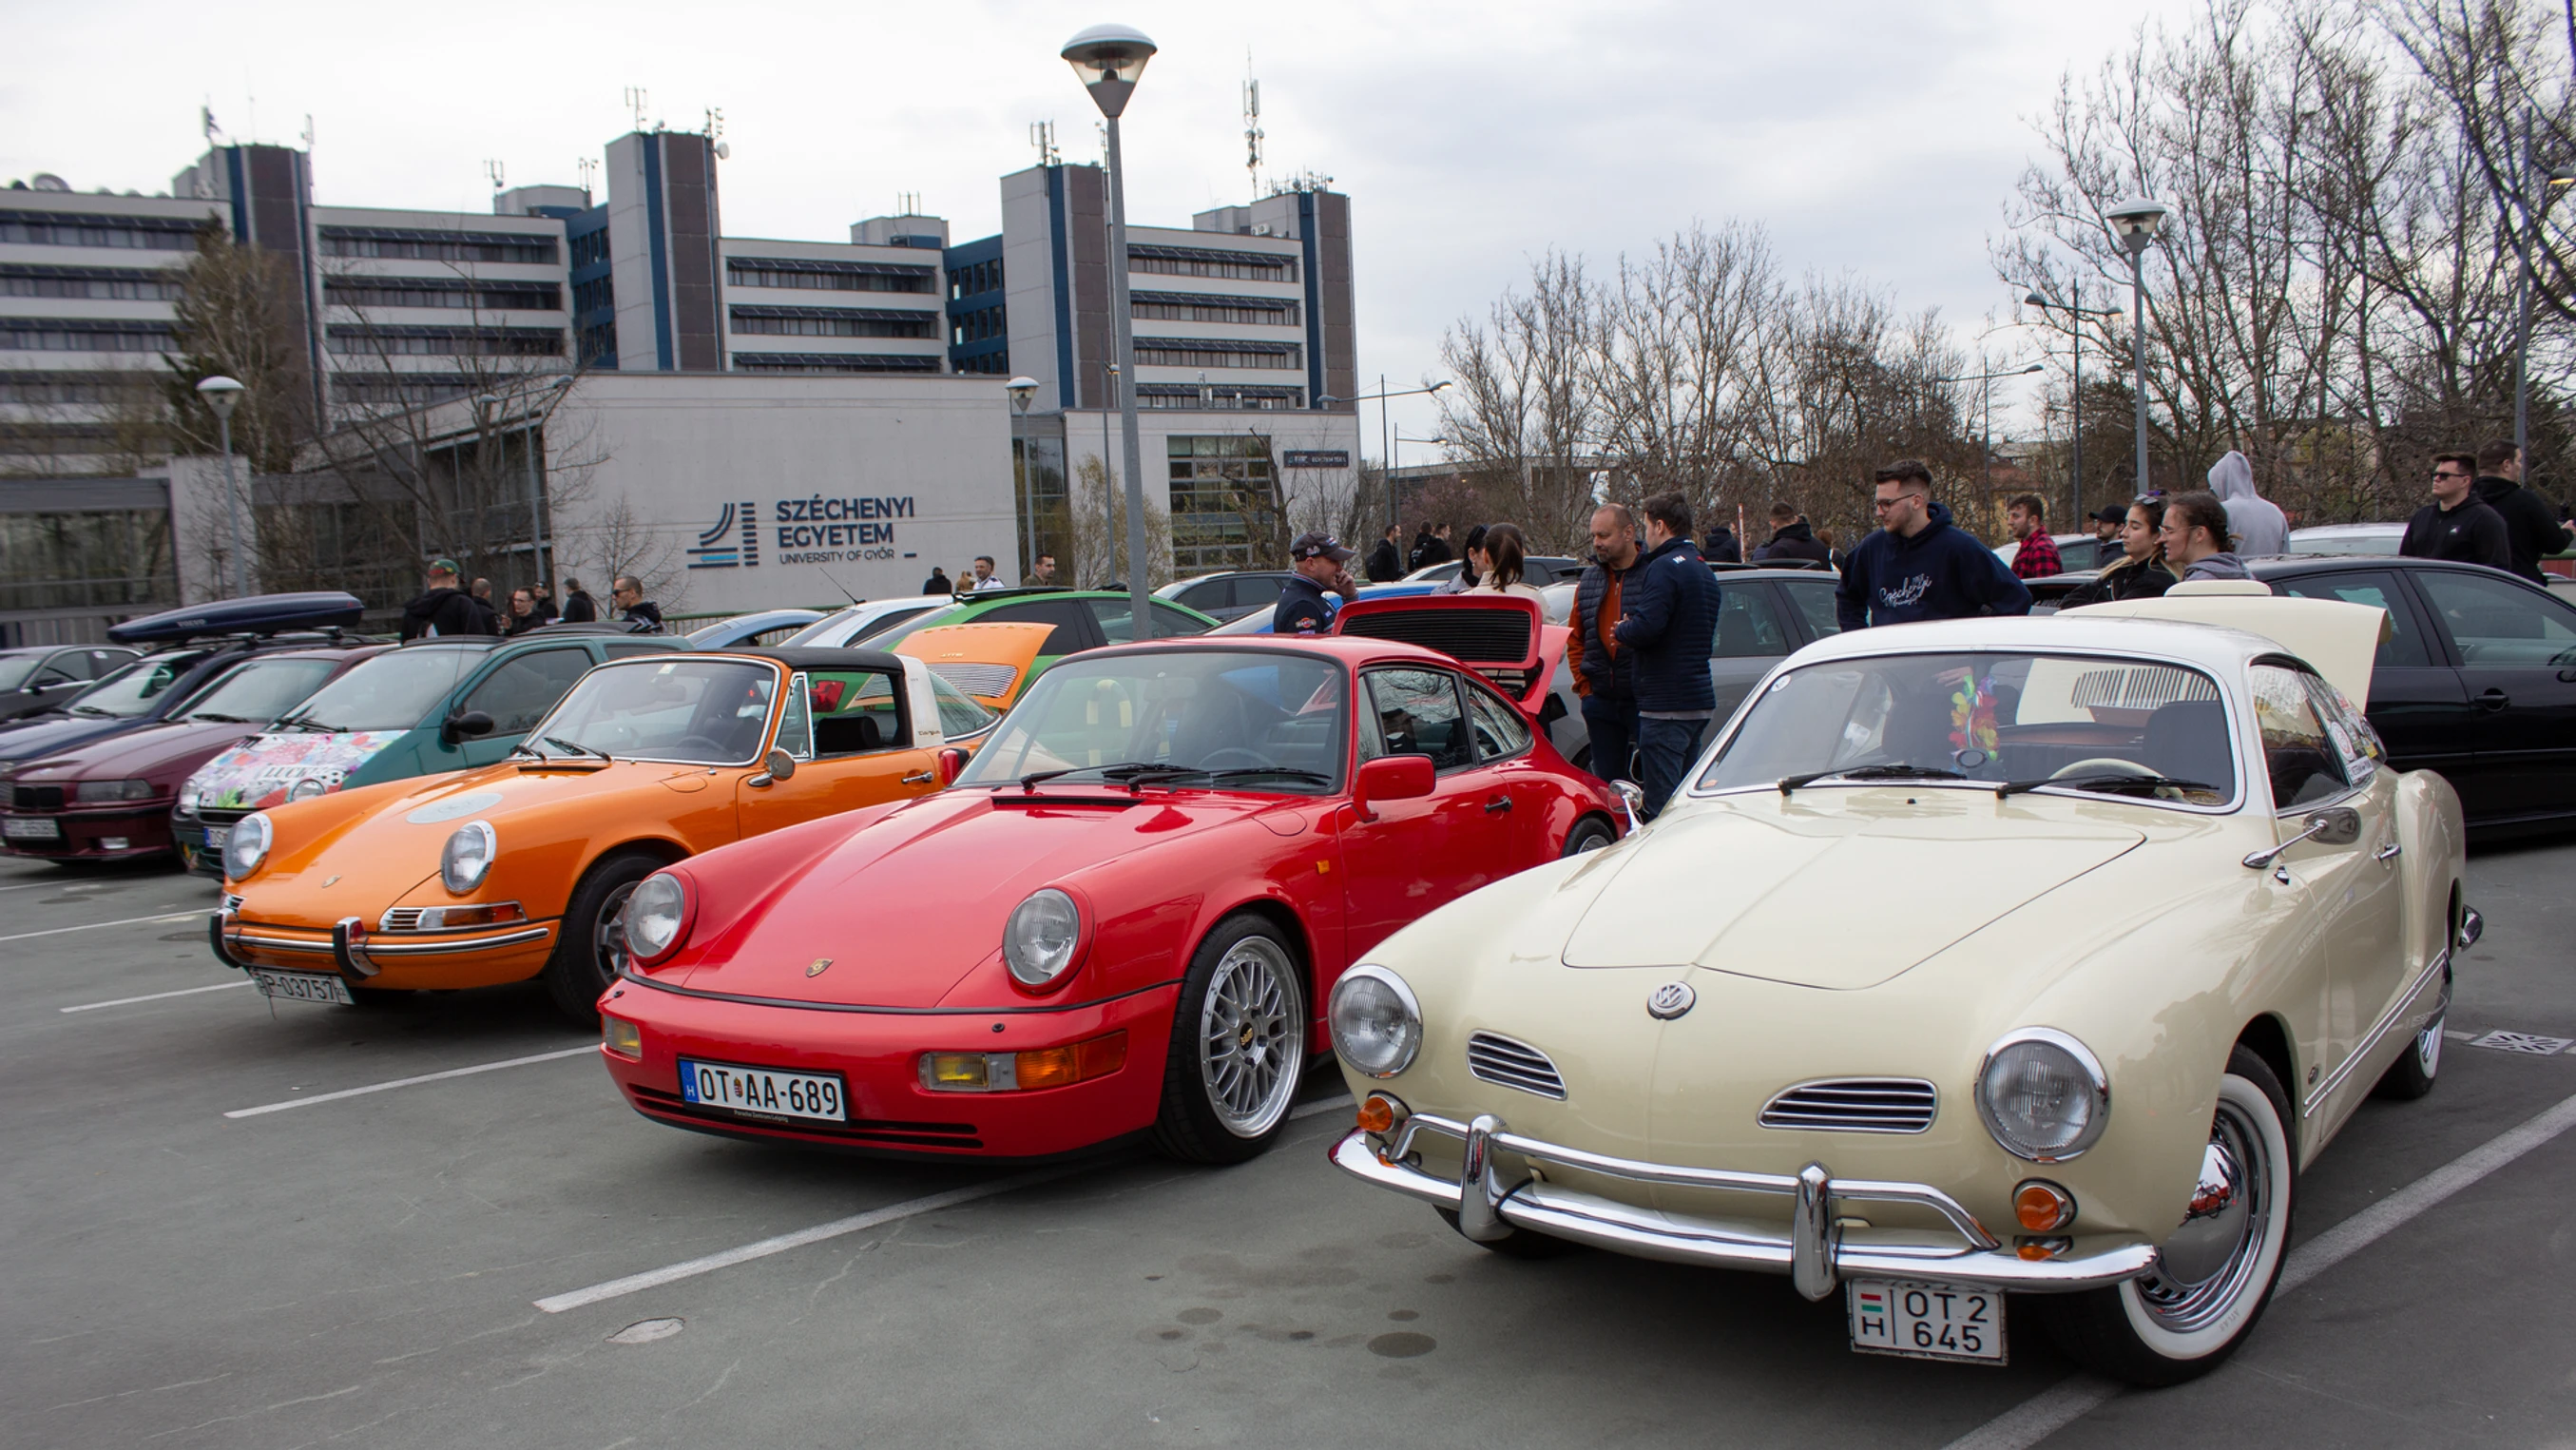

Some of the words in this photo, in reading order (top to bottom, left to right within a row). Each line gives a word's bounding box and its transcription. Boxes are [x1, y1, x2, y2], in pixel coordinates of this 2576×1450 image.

[776, 493, 914, 522] SZÉCHENYI
[778, 523, 894, 548] EGYETEM
[779, 551, 843, 565] UNIVERSITY
[846, 551, 862, 561] OF
[864, 547, 894, 560] GYŐR
[686, 1084, 695, 1097] H
[700, 1068, 729, 1102] OT
[746, 1073, 838, 1115] AA-689
[1861, 1315, 1884, 1337] H
[1913, 1321, 1982, 1352] 645
